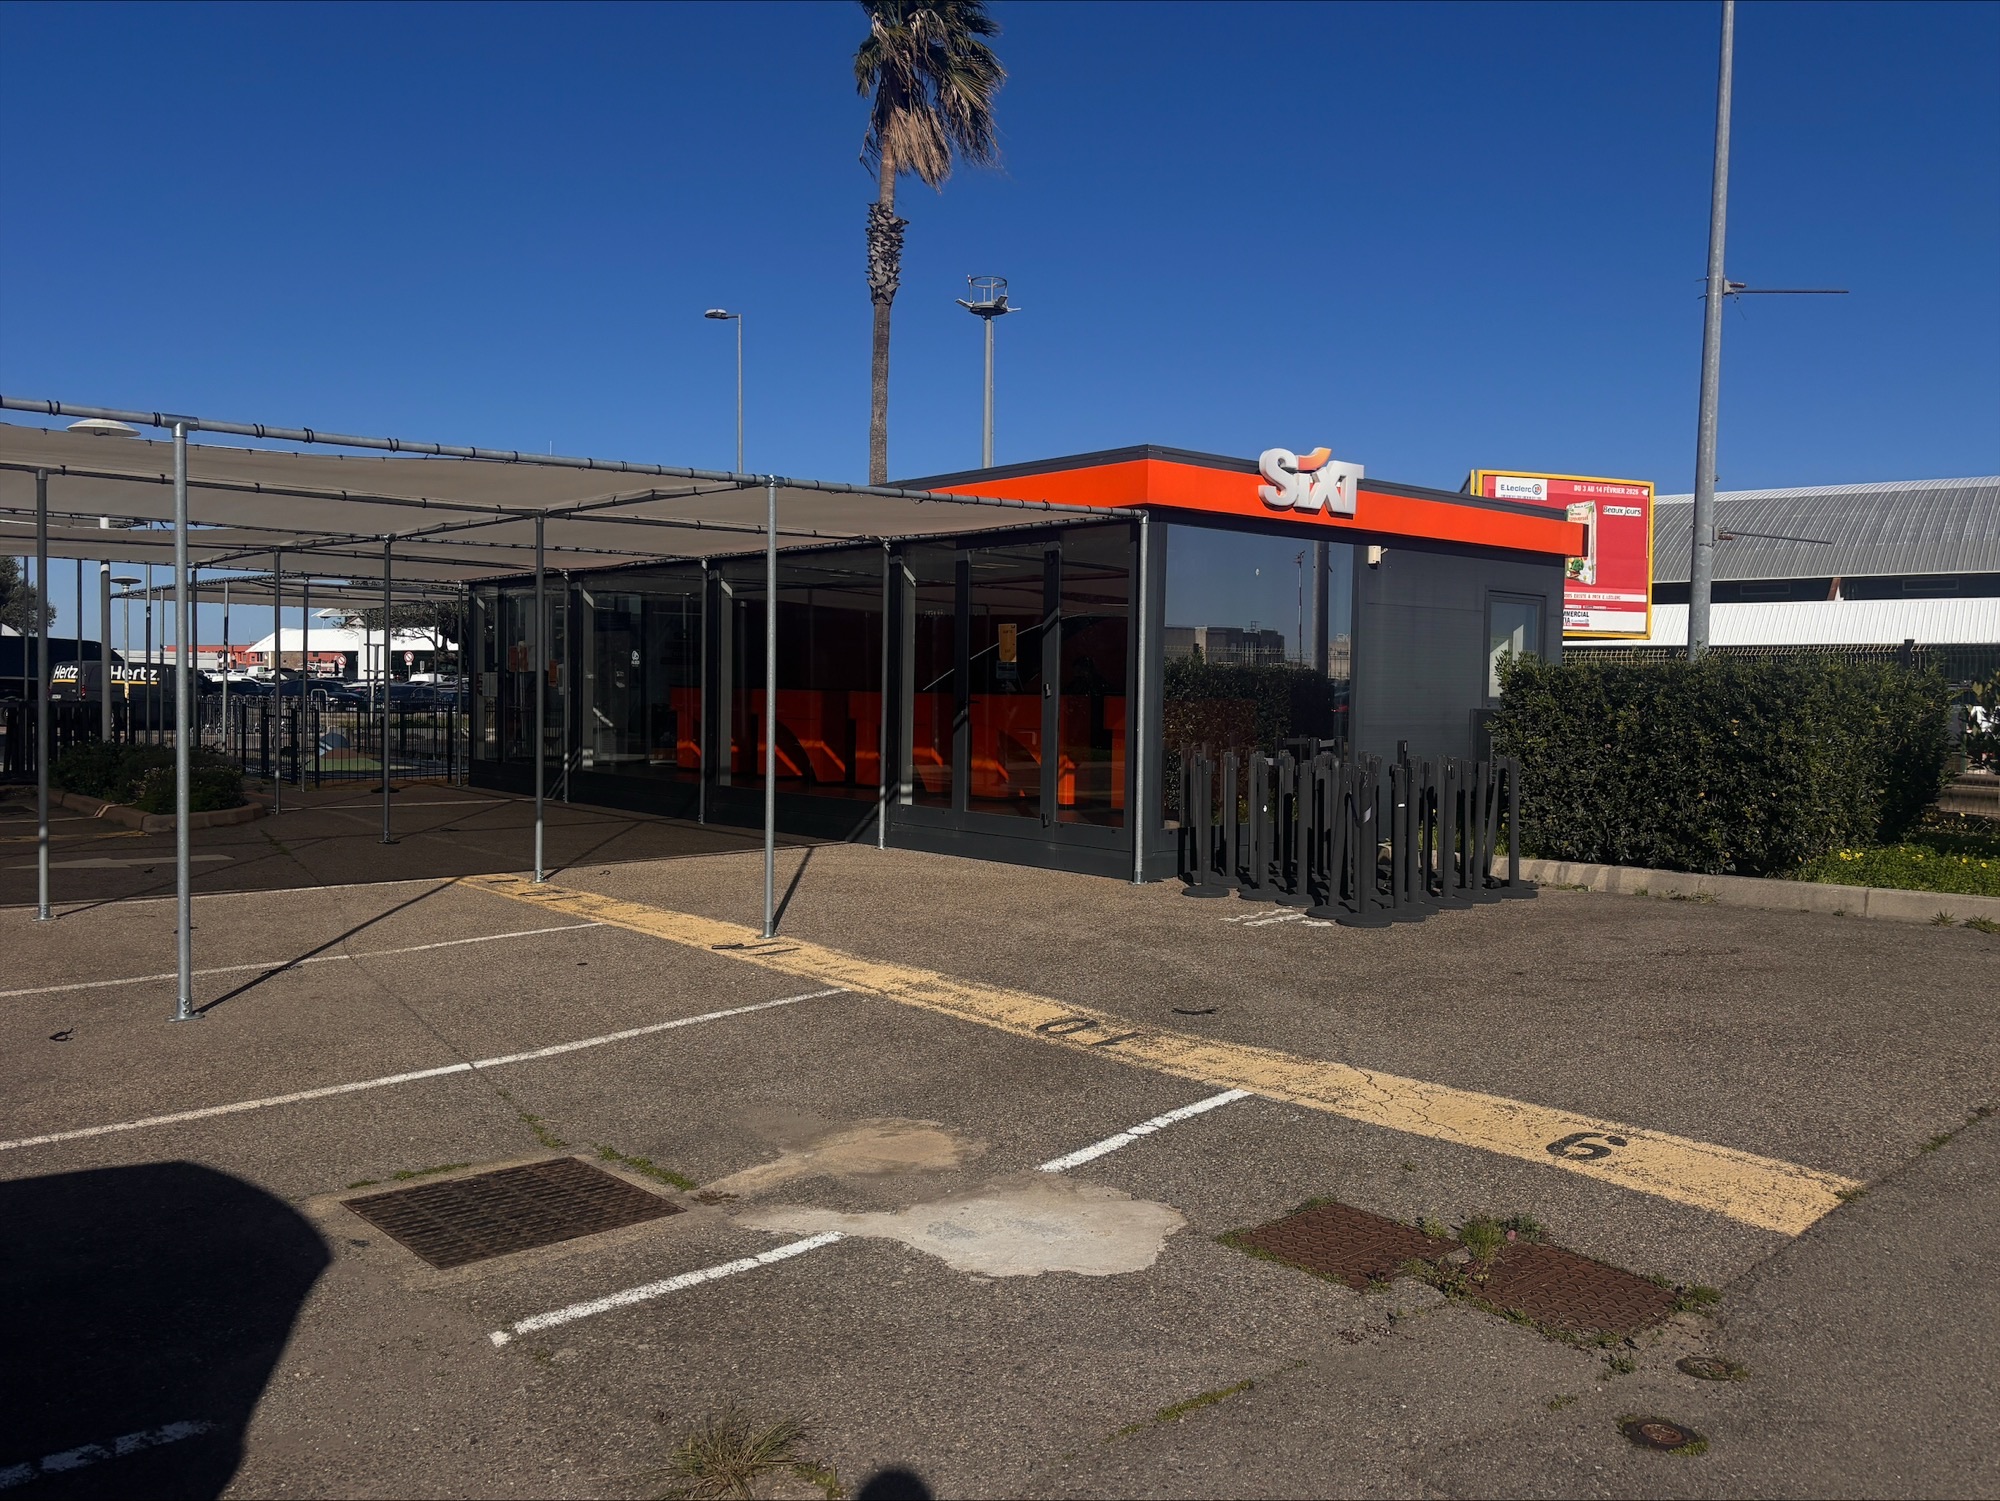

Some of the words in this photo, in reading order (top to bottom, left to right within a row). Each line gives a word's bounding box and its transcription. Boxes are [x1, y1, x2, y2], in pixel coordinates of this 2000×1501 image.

[1500, 484, 1532, 493] E.Leclerc
[1573, 484, 1582, 492] DU
[1603, 506, 1623, 514] Beaux
[1624, 507, 1641, 516] jours
[53, 665, 79, 679] Hertz
[110, 665, 158, 681] Hertz
